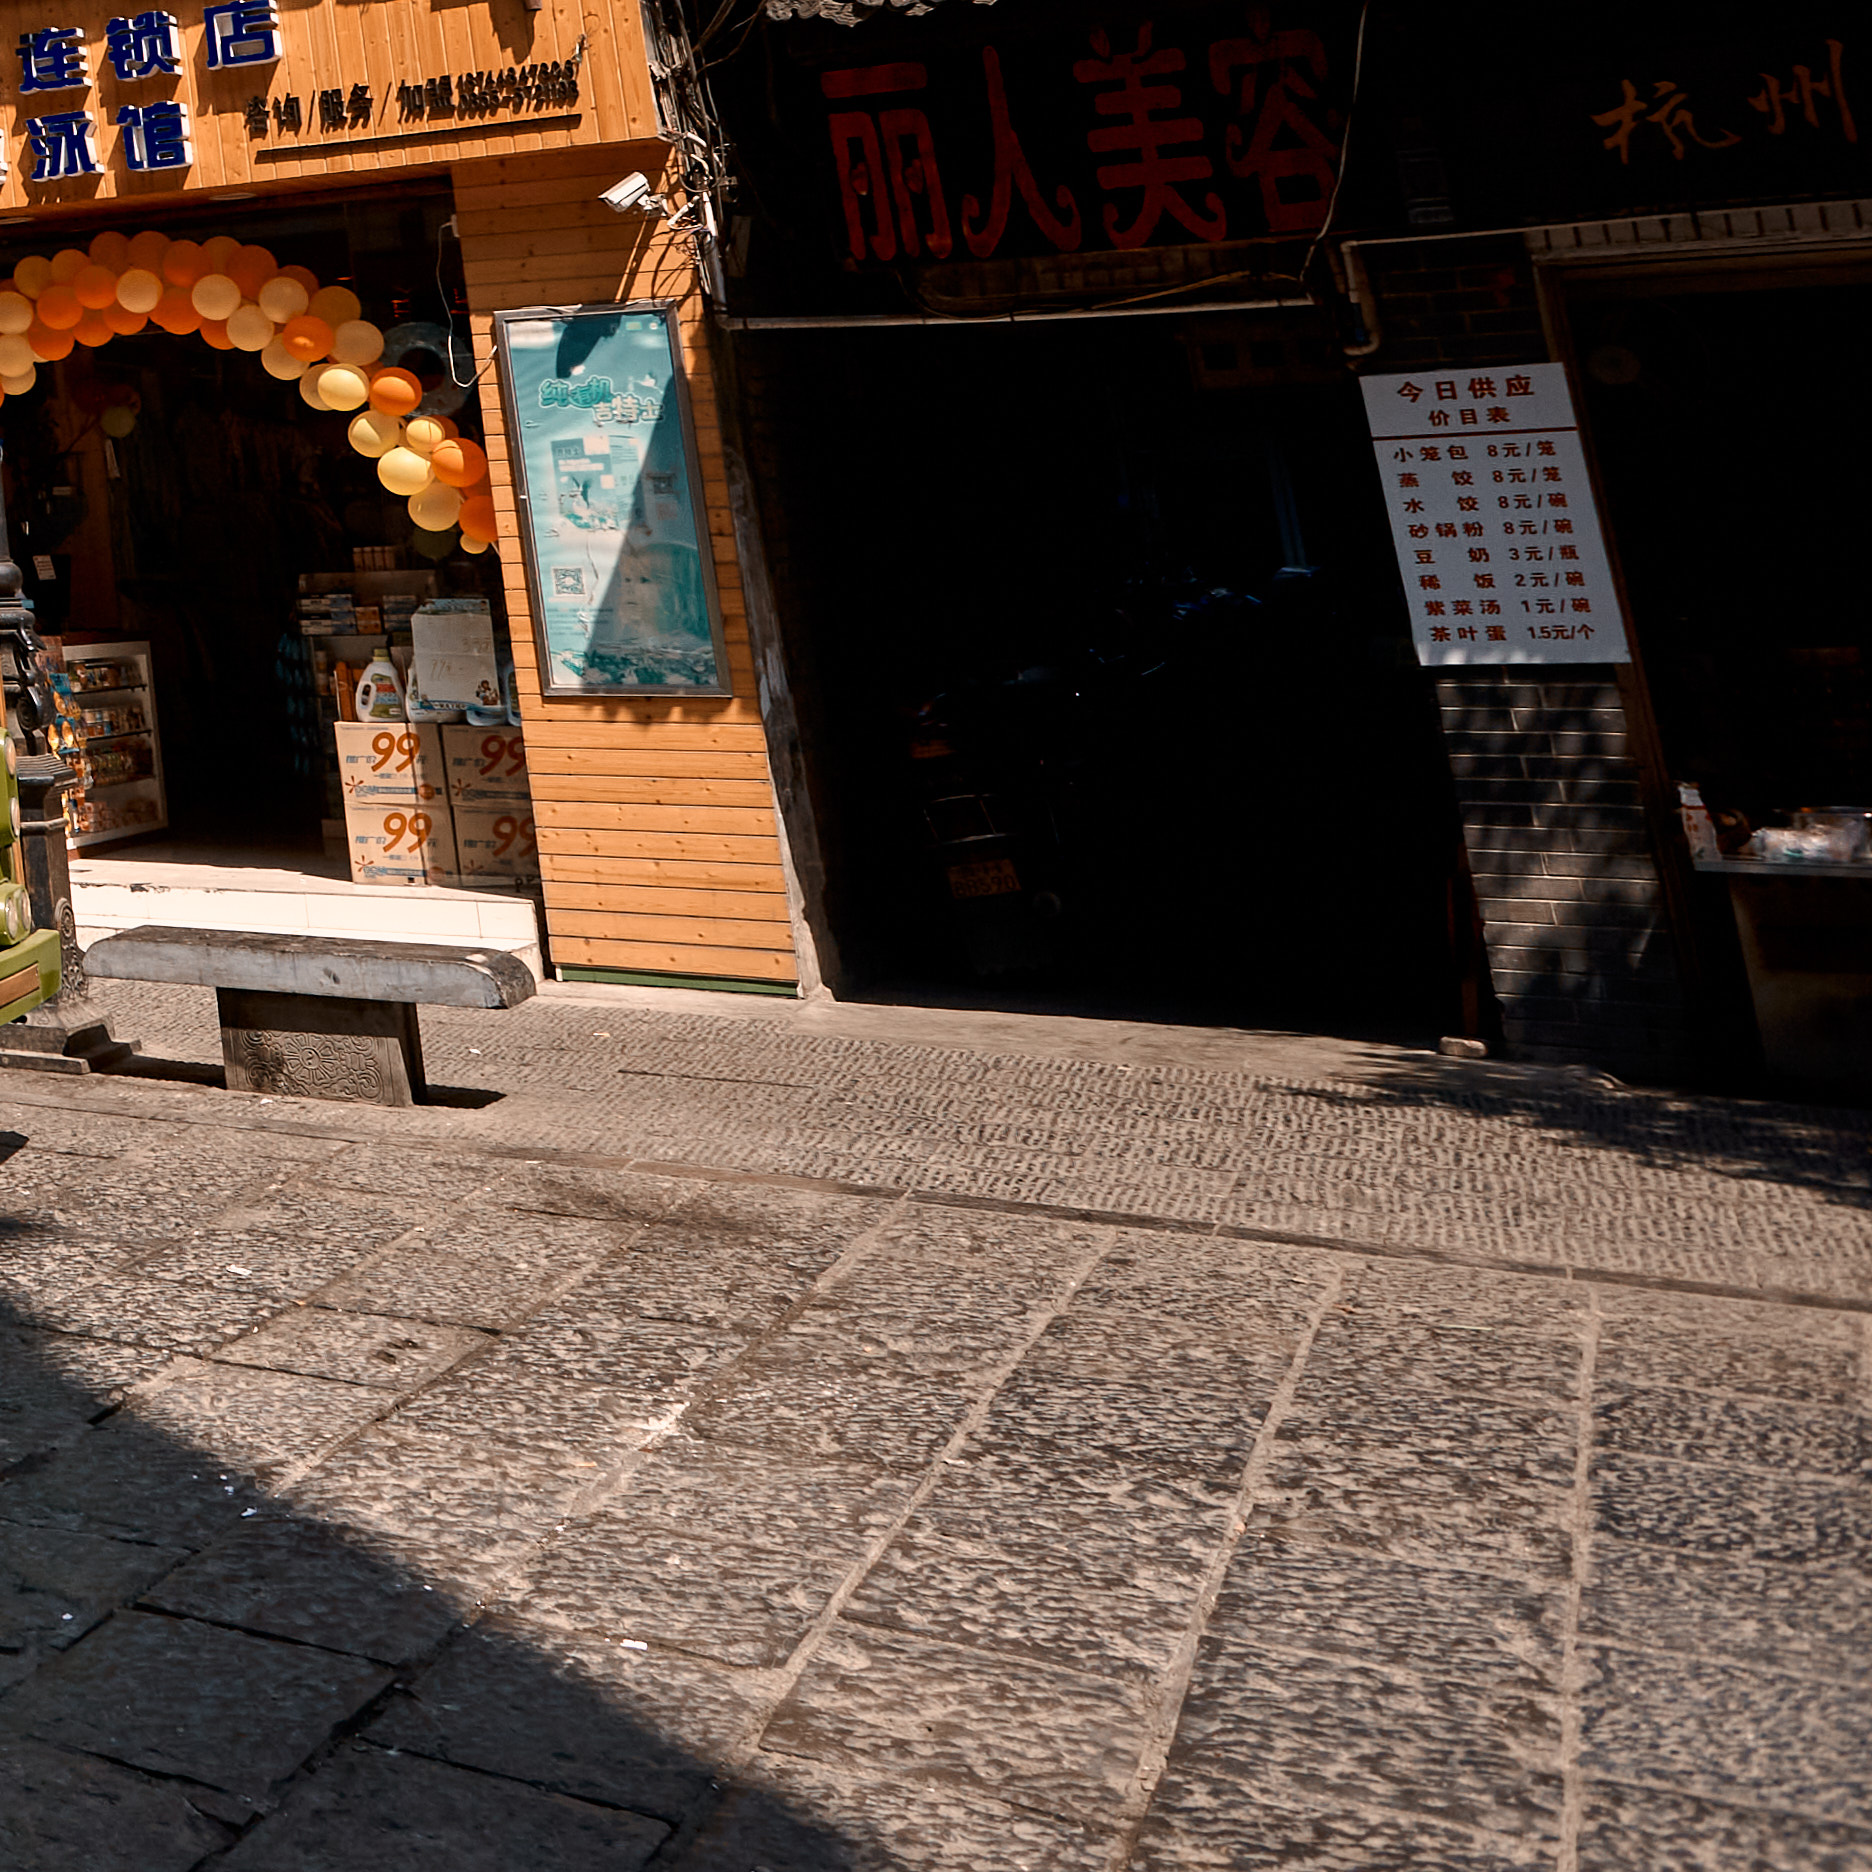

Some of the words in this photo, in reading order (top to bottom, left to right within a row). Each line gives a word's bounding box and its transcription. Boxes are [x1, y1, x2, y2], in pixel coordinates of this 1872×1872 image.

[1589, 38, 1858, 166] 杭州
[821, 8, 1344, 261] 丽人美容
[1397, 374, 1535, 403] 今日供应
[1428, 406, 1511, 427] 价目表
[1393, 444, 1469, 463] 小笼包
[1408, 522, 1484, 540] 砂锅粉
[1424, 600, 1502, 617] 紫菜汤
[1430, 626, 1507, 643] 茶叶蛋
[371, 731, 421, 772] 99
[383, 812, 433, 853] 99
